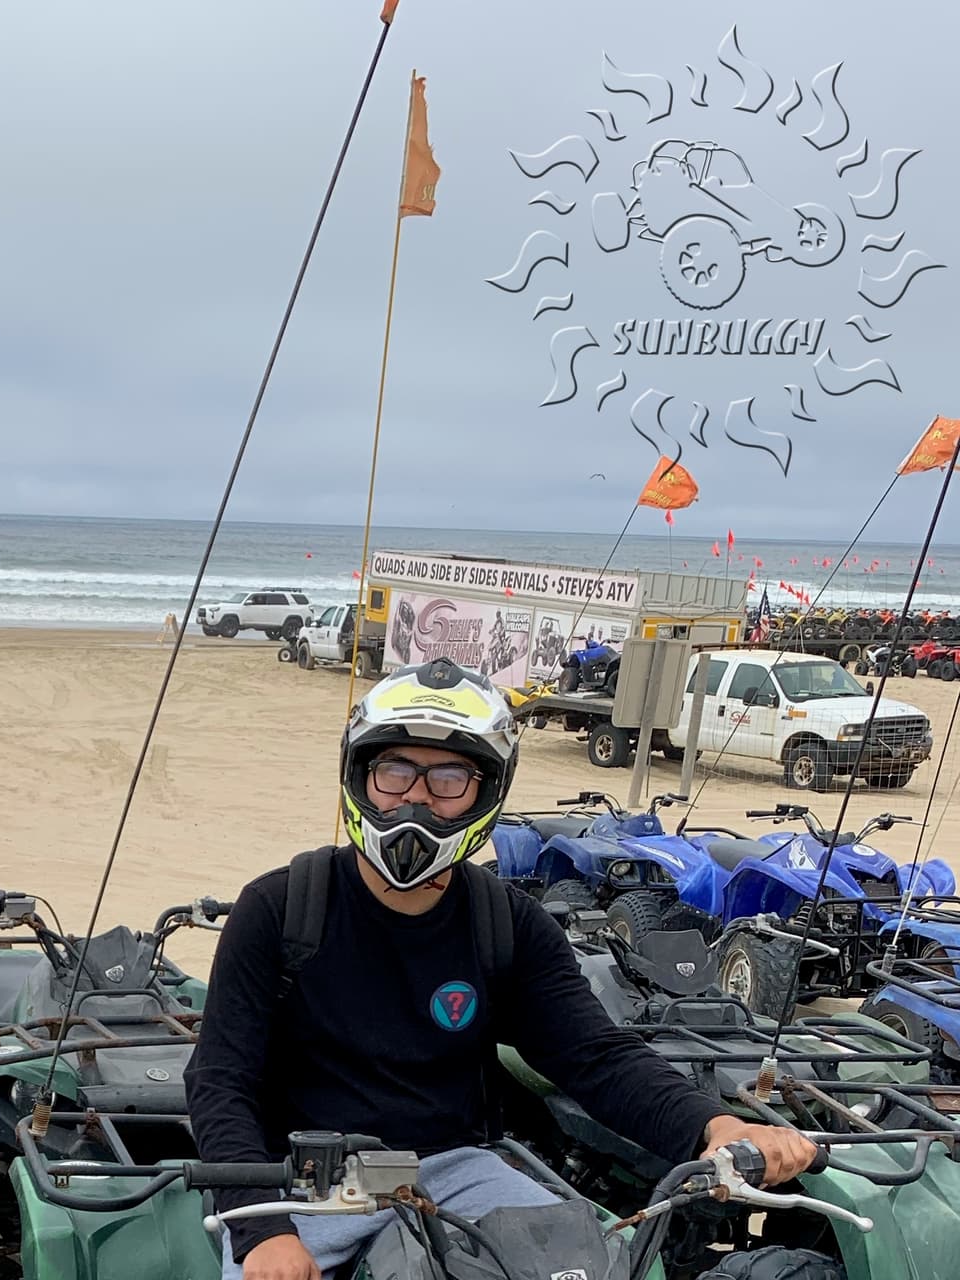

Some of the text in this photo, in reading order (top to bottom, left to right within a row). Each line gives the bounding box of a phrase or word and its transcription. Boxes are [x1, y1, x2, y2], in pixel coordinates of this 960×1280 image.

[374, 556, 634, 603] QUADS AND SIDE BY SIDES RENTALS STEVE'S ATV
